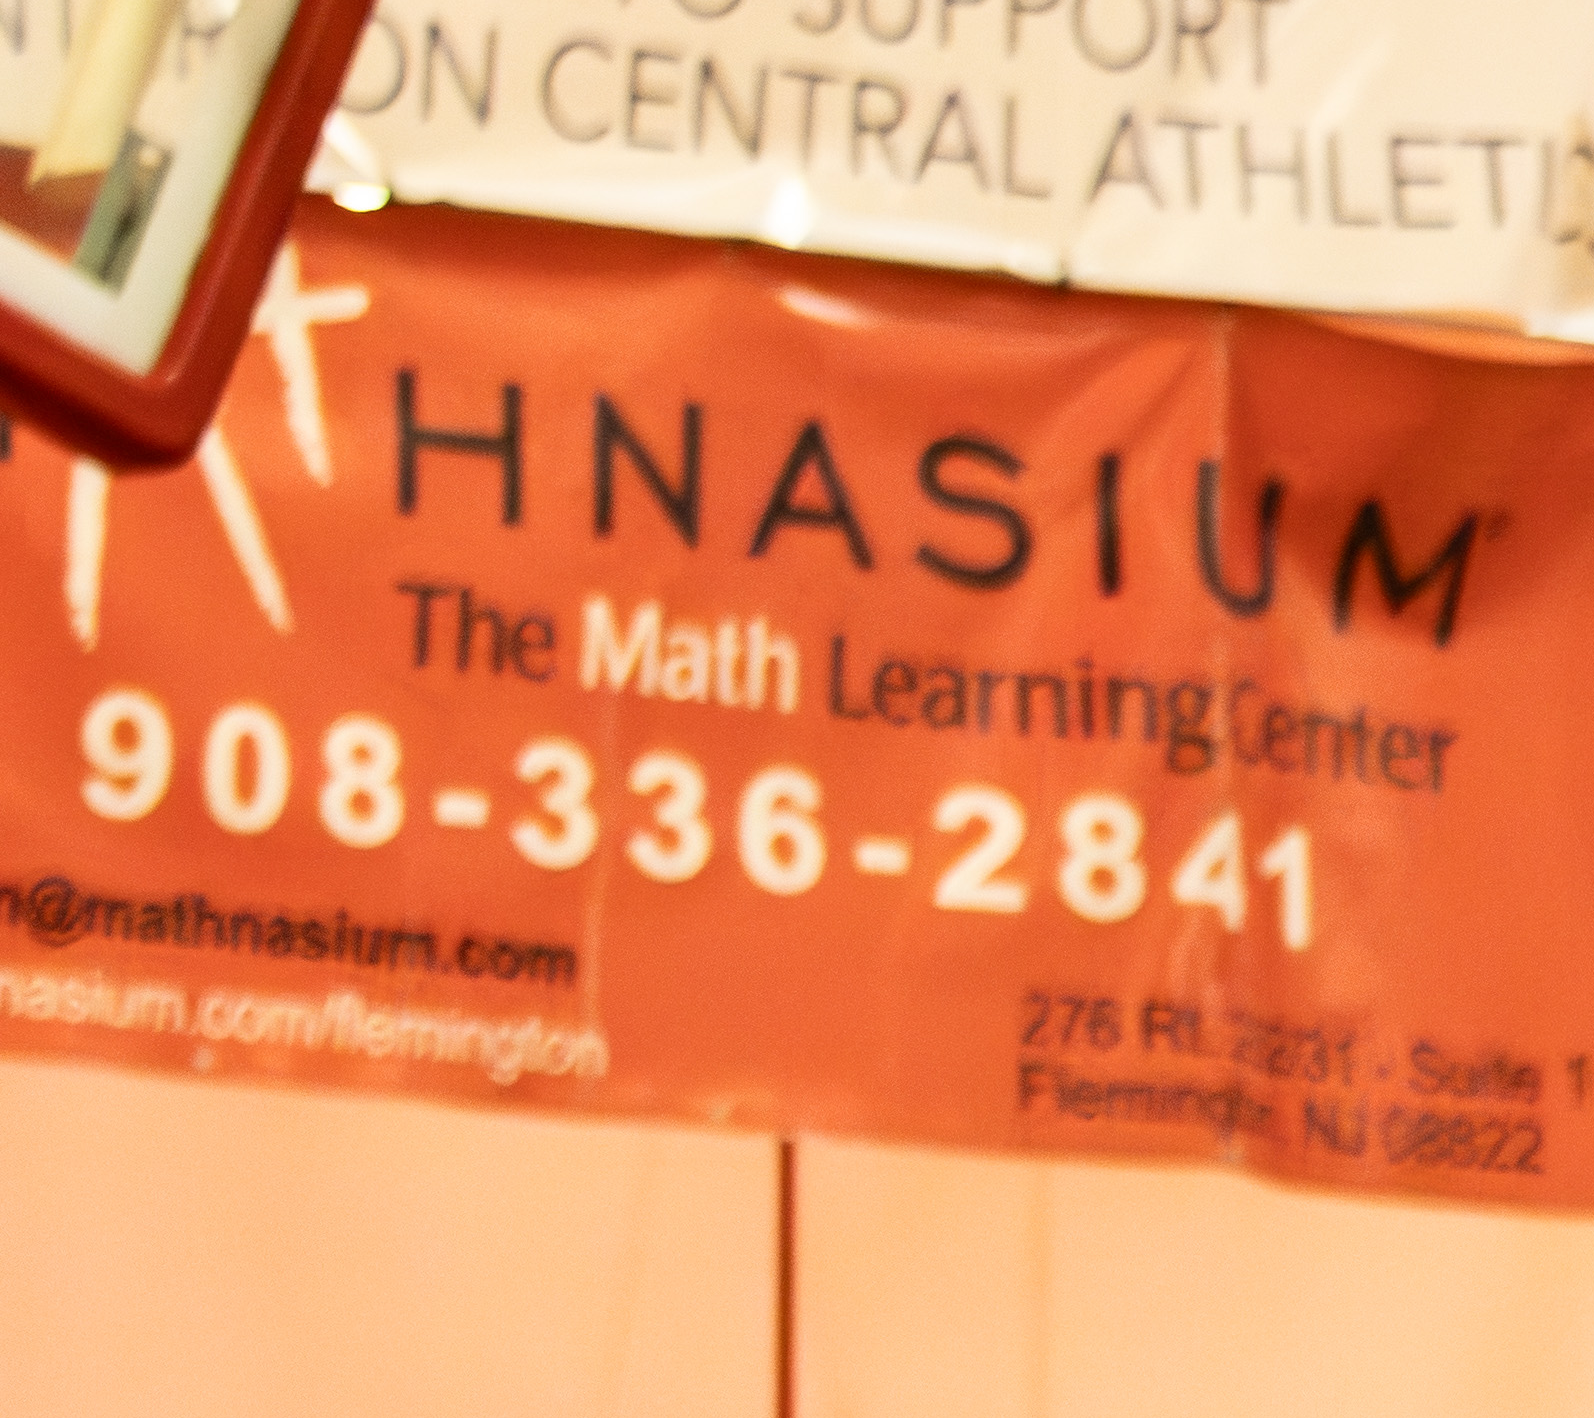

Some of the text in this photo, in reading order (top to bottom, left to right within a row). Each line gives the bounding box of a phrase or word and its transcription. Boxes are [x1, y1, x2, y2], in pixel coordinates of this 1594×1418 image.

[538, 33, 1055, 205] CENTRAL
[397, 576, 1460, 795] The Math Learning Center
[78, 683, 1316, 953] 908-336-2841
